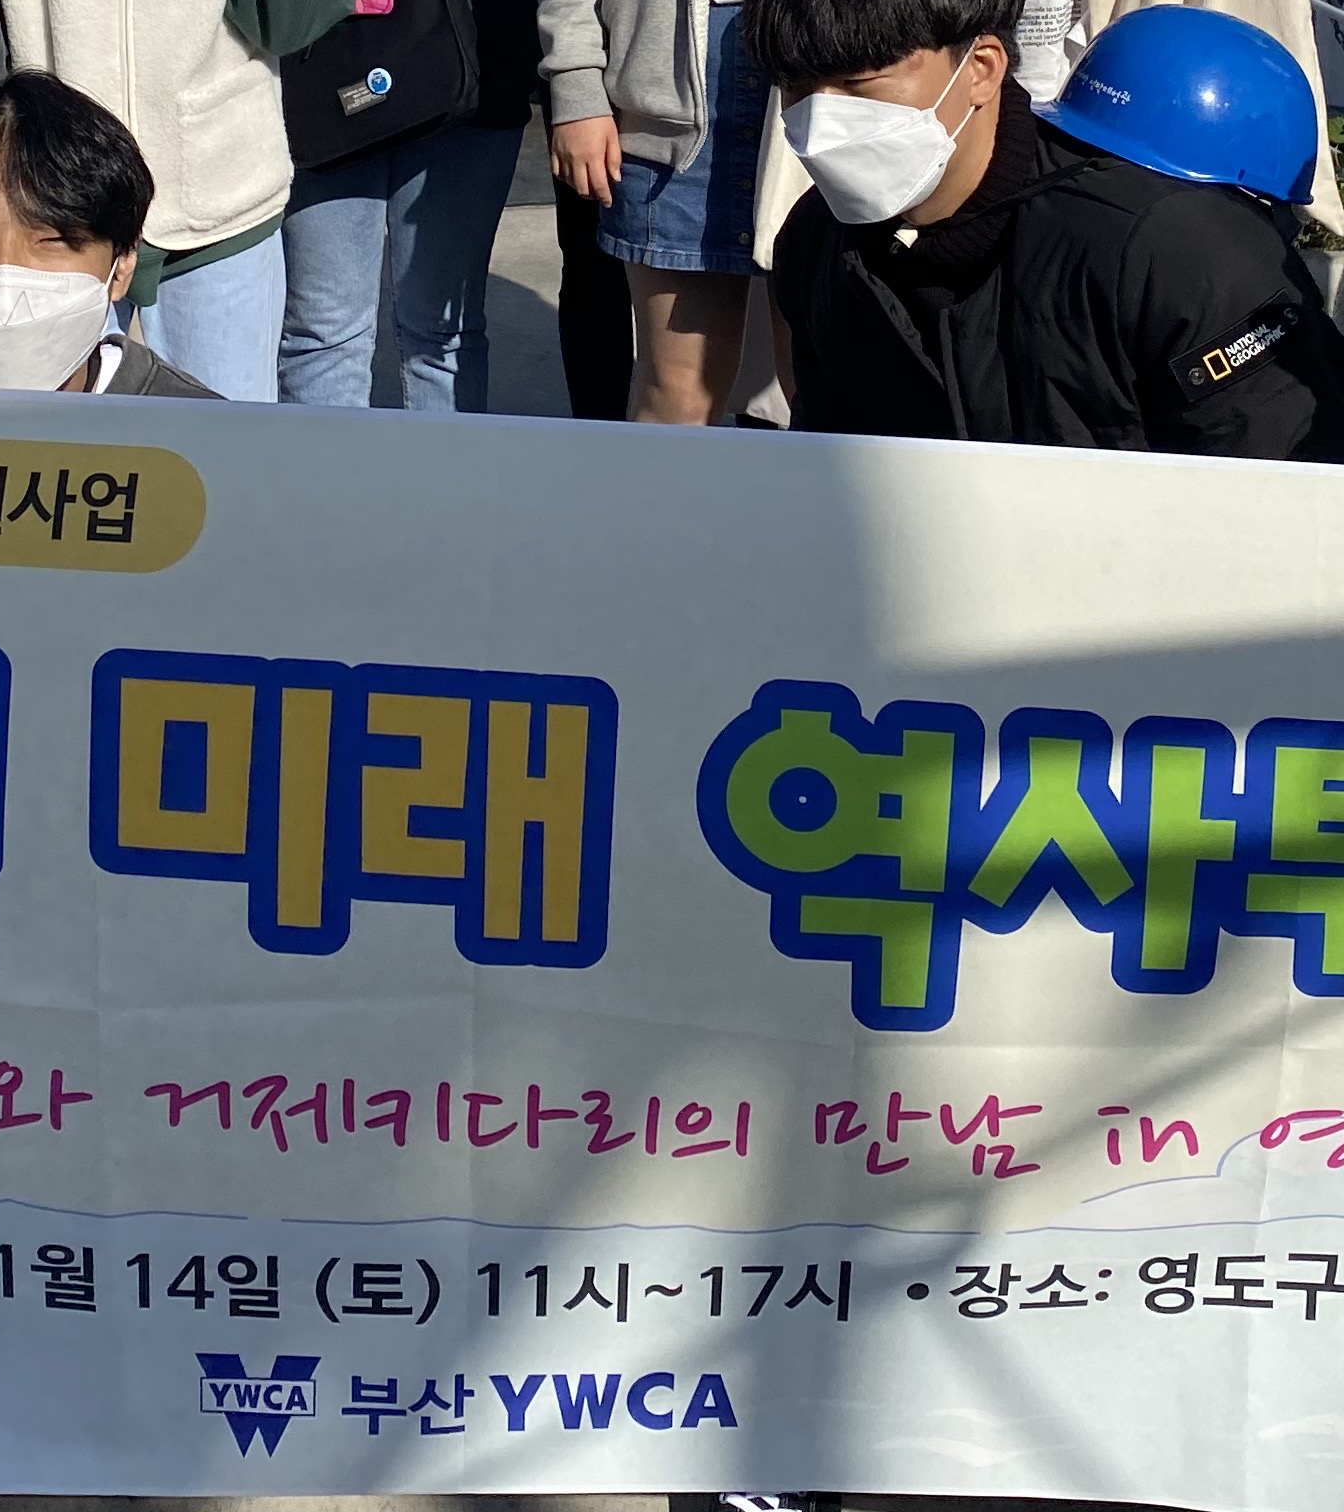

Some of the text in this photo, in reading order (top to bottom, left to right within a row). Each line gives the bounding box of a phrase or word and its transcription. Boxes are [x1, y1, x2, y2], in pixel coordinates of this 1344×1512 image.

[1224, 323, 1271, 357] NATIONAL
[1229, 324, 1286, 368] GEOGRAPHIC
[88, 648, 620, 969] 미래
[144, 1075, 752, 1160] 거제키다리의
[814, 1090, 1043, 1180] 만남
[1097, 1104, 1201, 1167] in
[125, 1252, 281, 1320] 14일
[314, 1256, 442, 1326] (토)
[476, 1259, 853, 1324] 11시~17시
[209, 1382, 309, 1412] YWCA
[340, 1370, 739, 1437] 부산 YWCA
